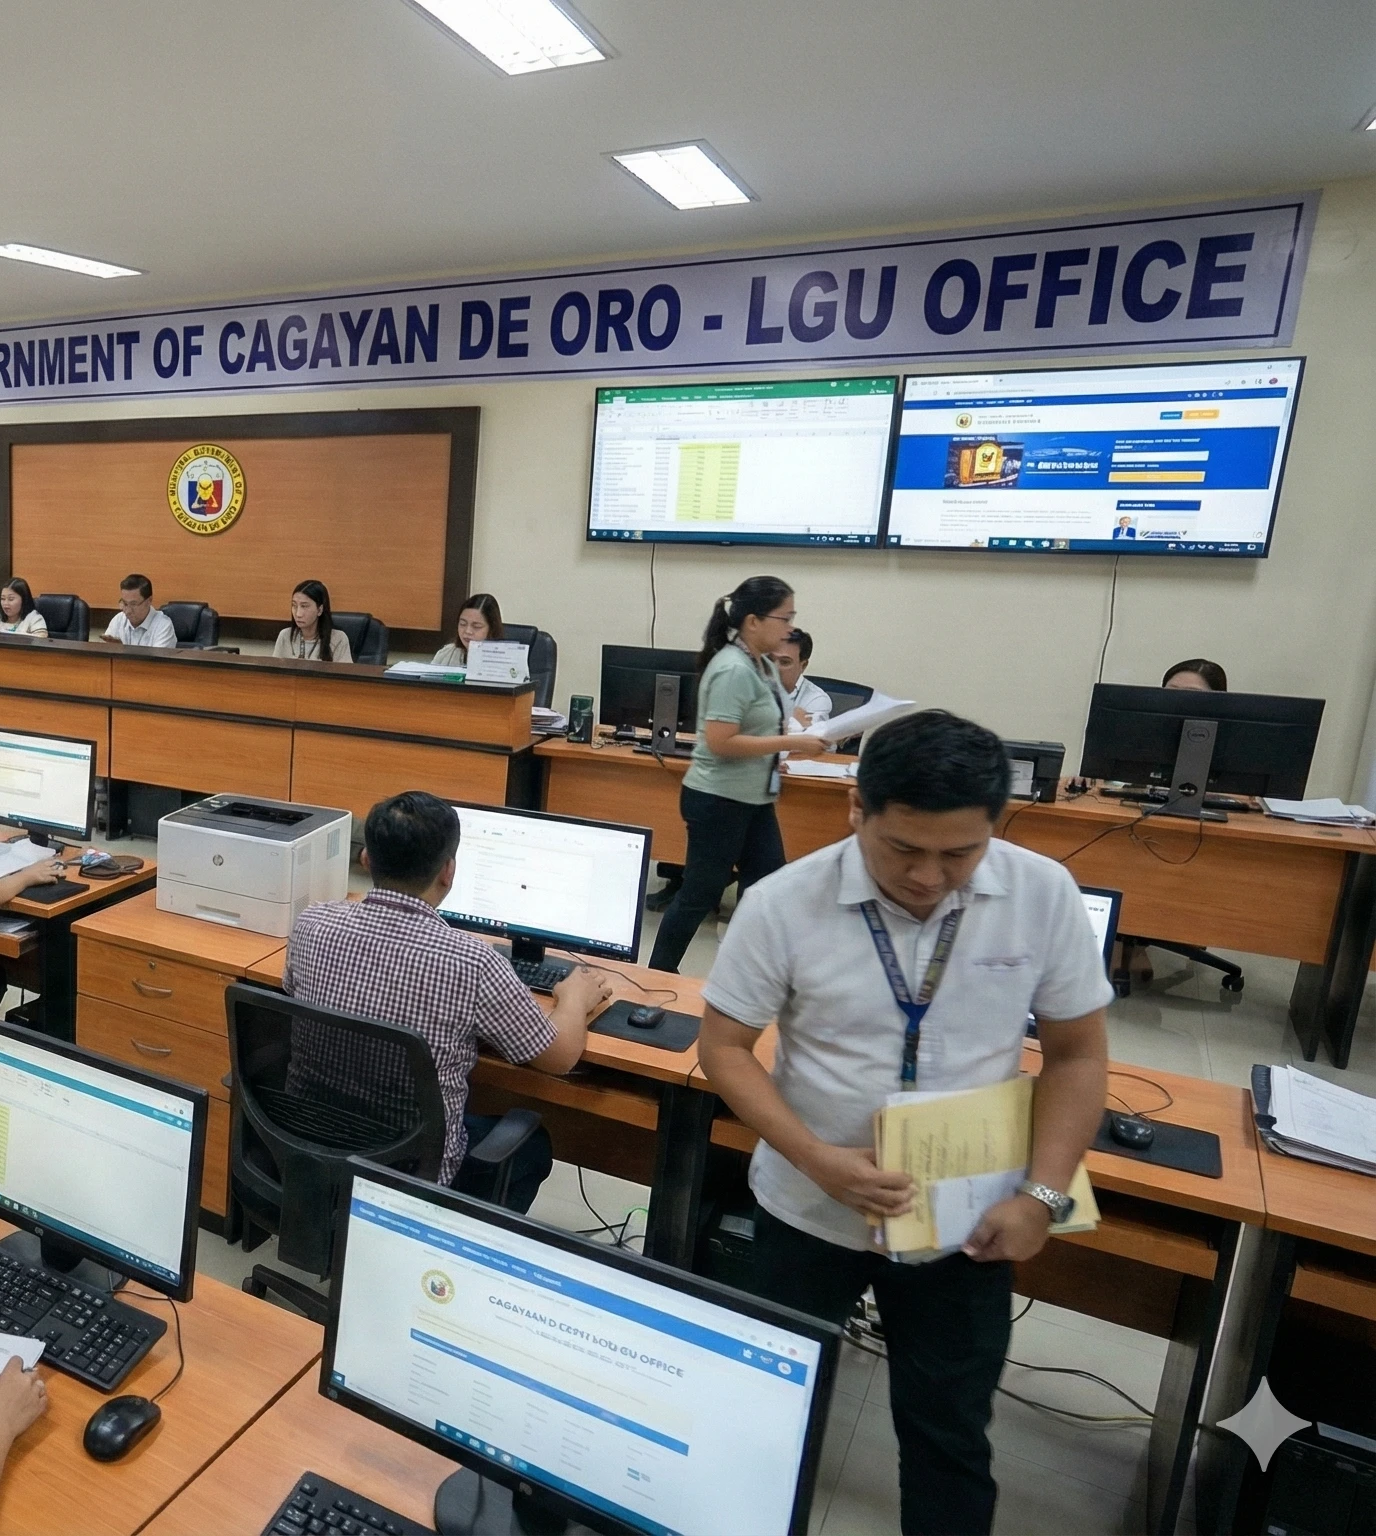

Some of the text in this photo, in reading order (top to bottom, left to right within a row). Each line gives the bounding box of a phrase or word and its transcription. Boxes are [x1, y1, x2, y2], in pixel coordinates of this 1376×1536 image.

[153, 325, 204, 379] OF
[218, 303, 439, 375] CAGAYAN
[459, 295, 531, 360] DE
[550, 284, 681, 356] ORO
[745, 265, 898, 345] LGU
[924, 232, 1255, 335] OFFICE
